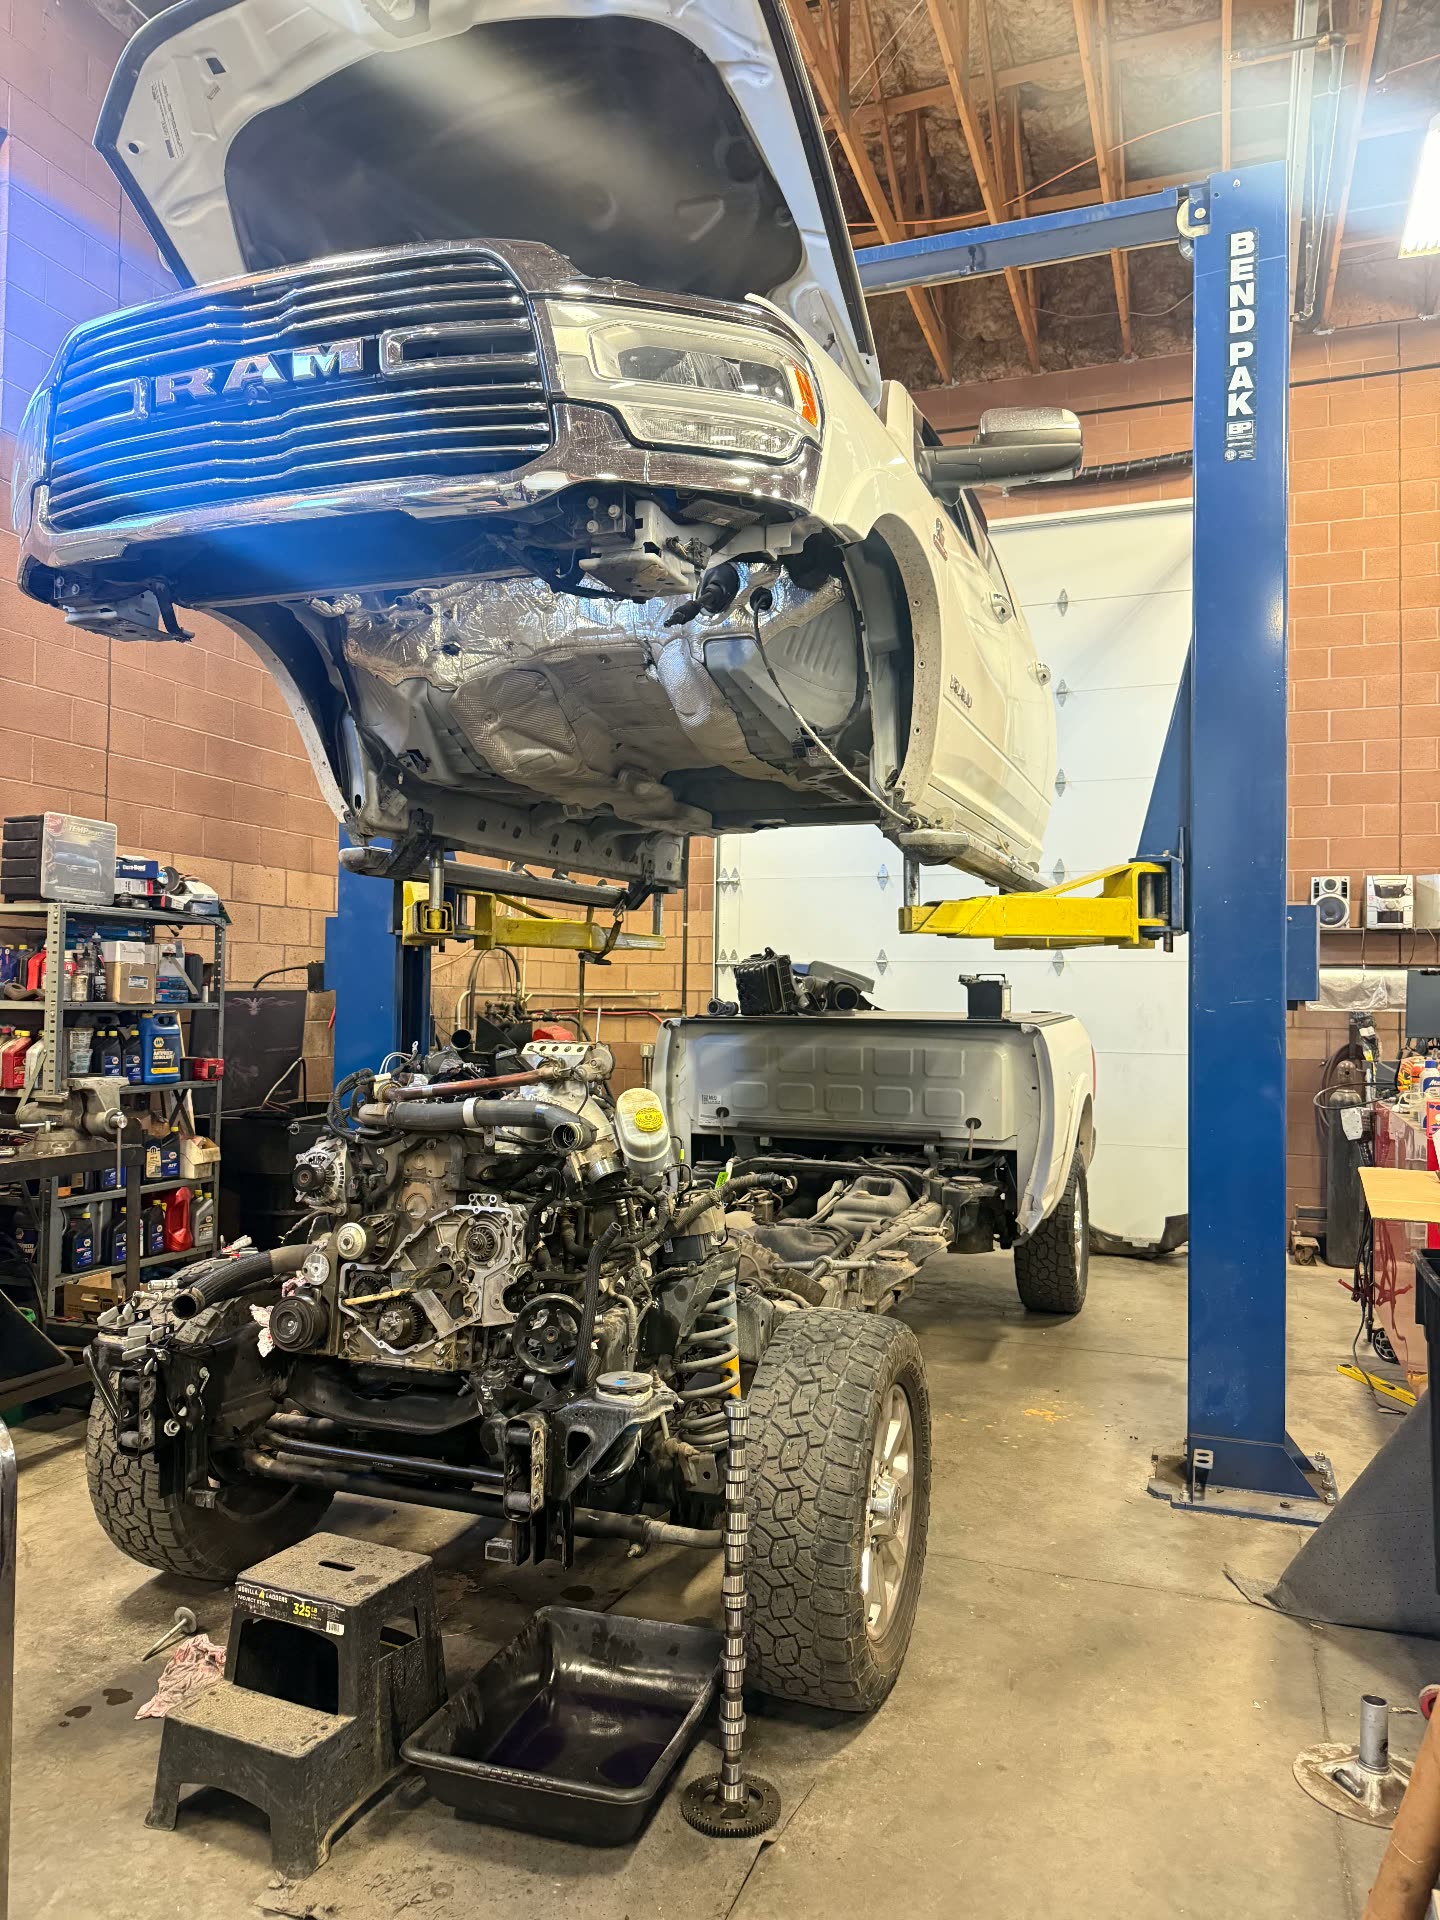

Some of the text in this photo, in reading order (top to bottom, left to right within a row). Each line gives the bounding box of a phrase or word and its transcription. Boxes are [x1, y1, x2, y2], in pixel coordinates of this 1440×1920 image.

[155, 338, 364, 406] RAM
[237, 1595, 256, 1604] PROJECT
[265, 1593, 288, 1603] LADDERS
[292, 1602, 311, 1618] 325
[311, 1606, 318, 1614] LB
